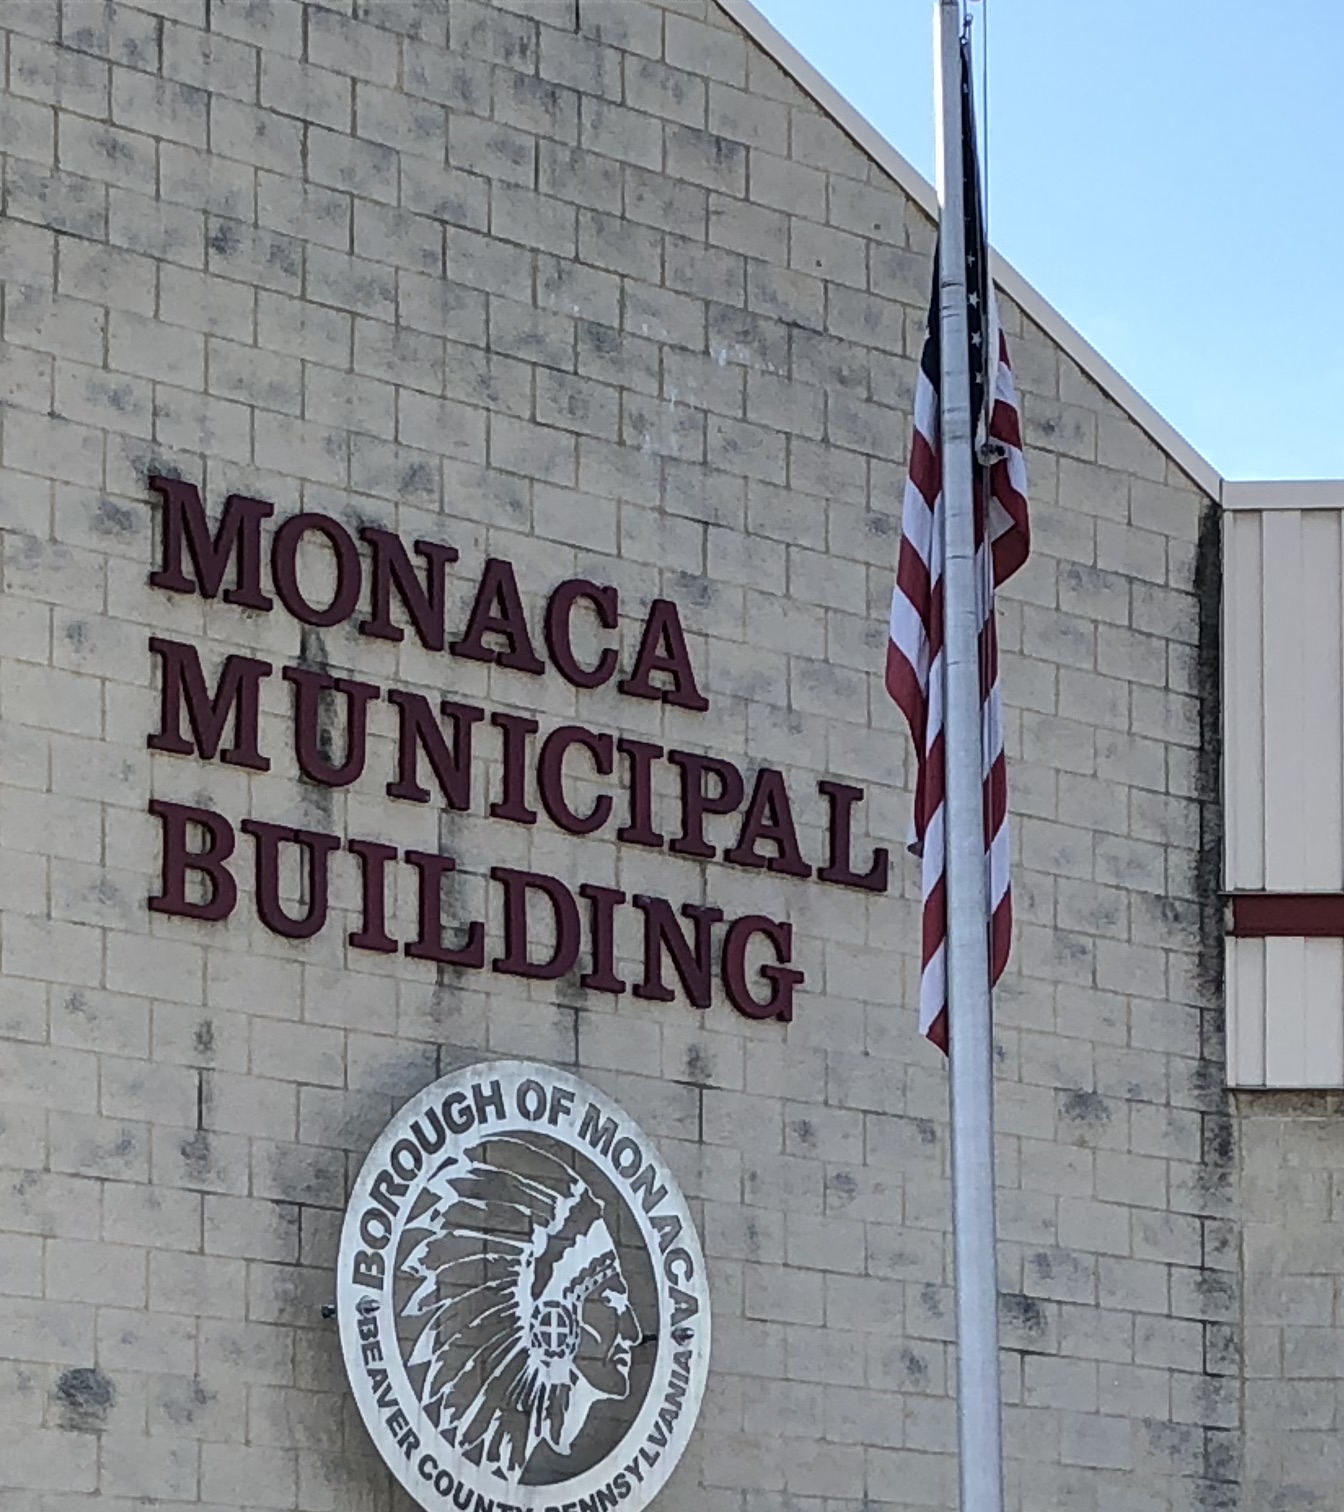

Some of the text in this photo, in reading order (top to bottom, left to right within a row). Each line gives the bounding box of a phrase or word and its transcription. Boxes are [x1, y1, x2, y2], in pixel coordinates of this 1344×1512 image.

[150, 476, 709, 712] MONACA
[148, 637, 890, 892] MUNICIPAL
[148, 800, 805, 1023] BUILDING
[351, 1078, 700, 1322] BOROUGH OF MONACA
[357, 1316, 418, 1461] BEAVER
